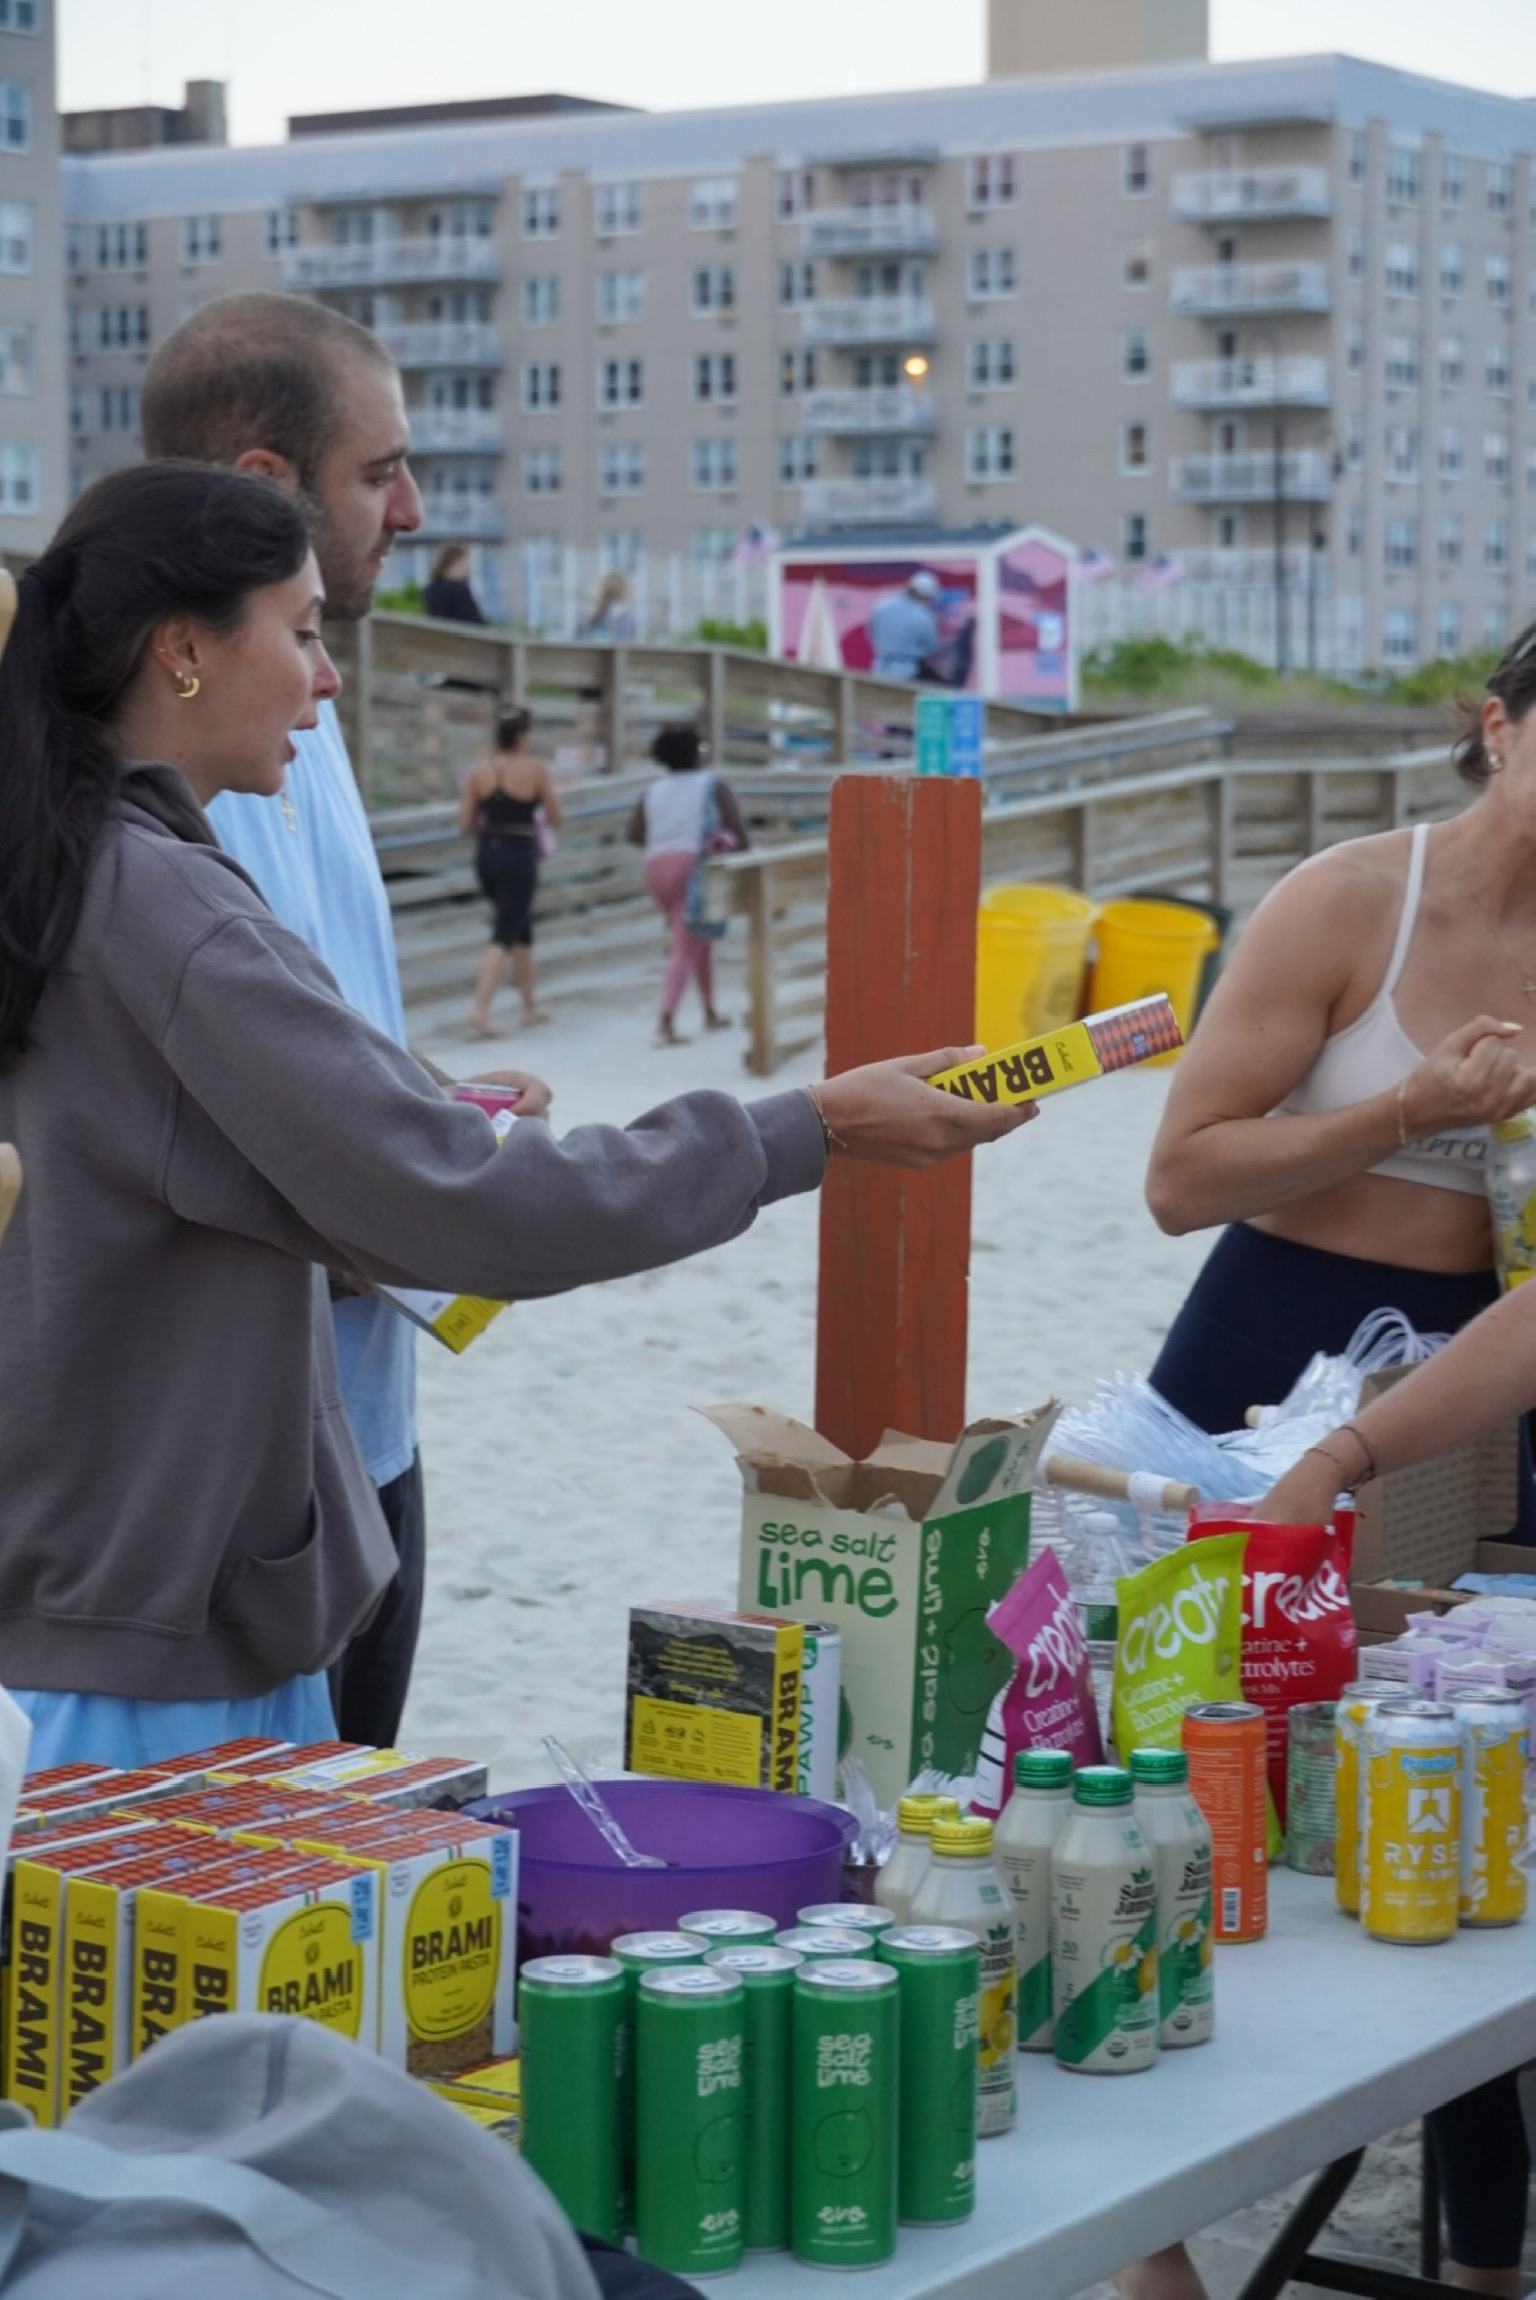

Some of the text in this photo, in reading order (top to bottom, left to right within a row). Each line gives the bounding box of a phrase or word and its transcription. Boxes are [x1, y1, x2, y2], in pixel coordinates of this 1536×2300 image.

[936, 1046, 1055, 1104] BRAM
[758, 1521, 898, 1564] sea salt
[1239, 1656, 1317, 1682] trolytes
[1240, 1638, 1292, 1655] atine
[921, 1640, 940, 1723] salt
[775, 1671, 798, 1793] BRAM
[1384, 1841, 1460, 1865] RYSE
[412, 1915, 492, 1970] BRAMI
[15, 1919, 51, 2092] BRAMI
[141, 1947, 177, 2052] BRA
[267, 1959, 353, 2014] BRAMI
